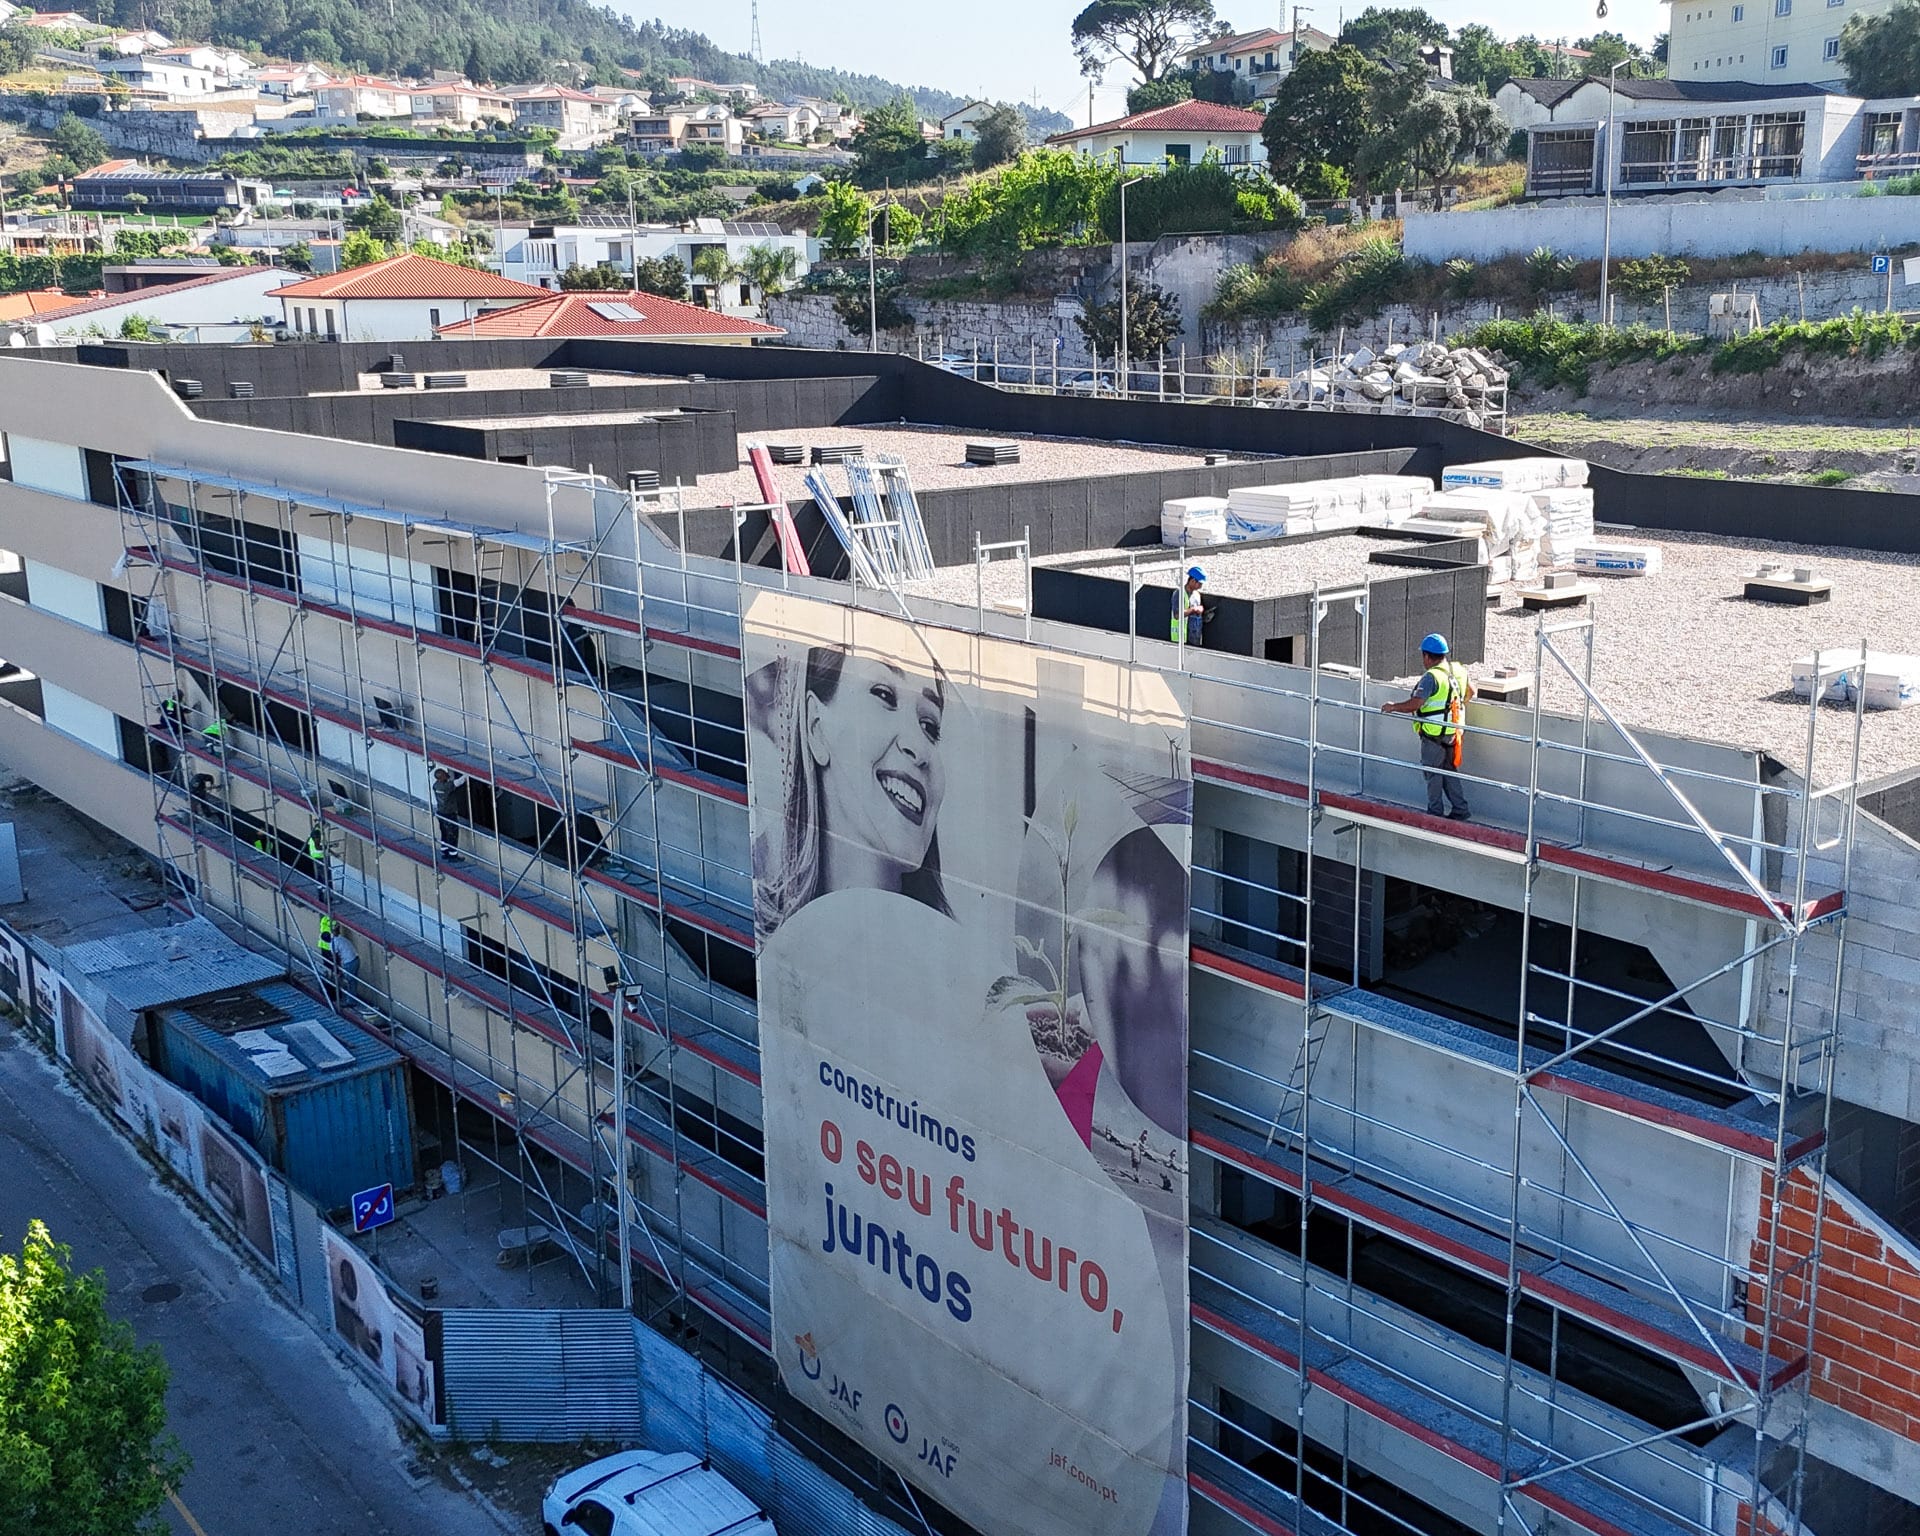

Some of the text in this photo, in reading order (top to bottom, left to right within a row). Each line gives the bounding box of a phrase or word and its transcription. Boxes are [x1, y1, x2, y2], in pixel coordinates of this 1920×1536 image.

[1874, 257, 1886, 271] P
[819, 1060, 977, 1163] construímos
[820, 1119, 1125, 1335] o seu futuro,
[821, 1182, 973, 1323] juntos
[829, 1374, 863, 1412] JAF
[917, 1437, 958, 1479] JAF
[1048, 1446, 1119, 1505] jaf.com.pt
